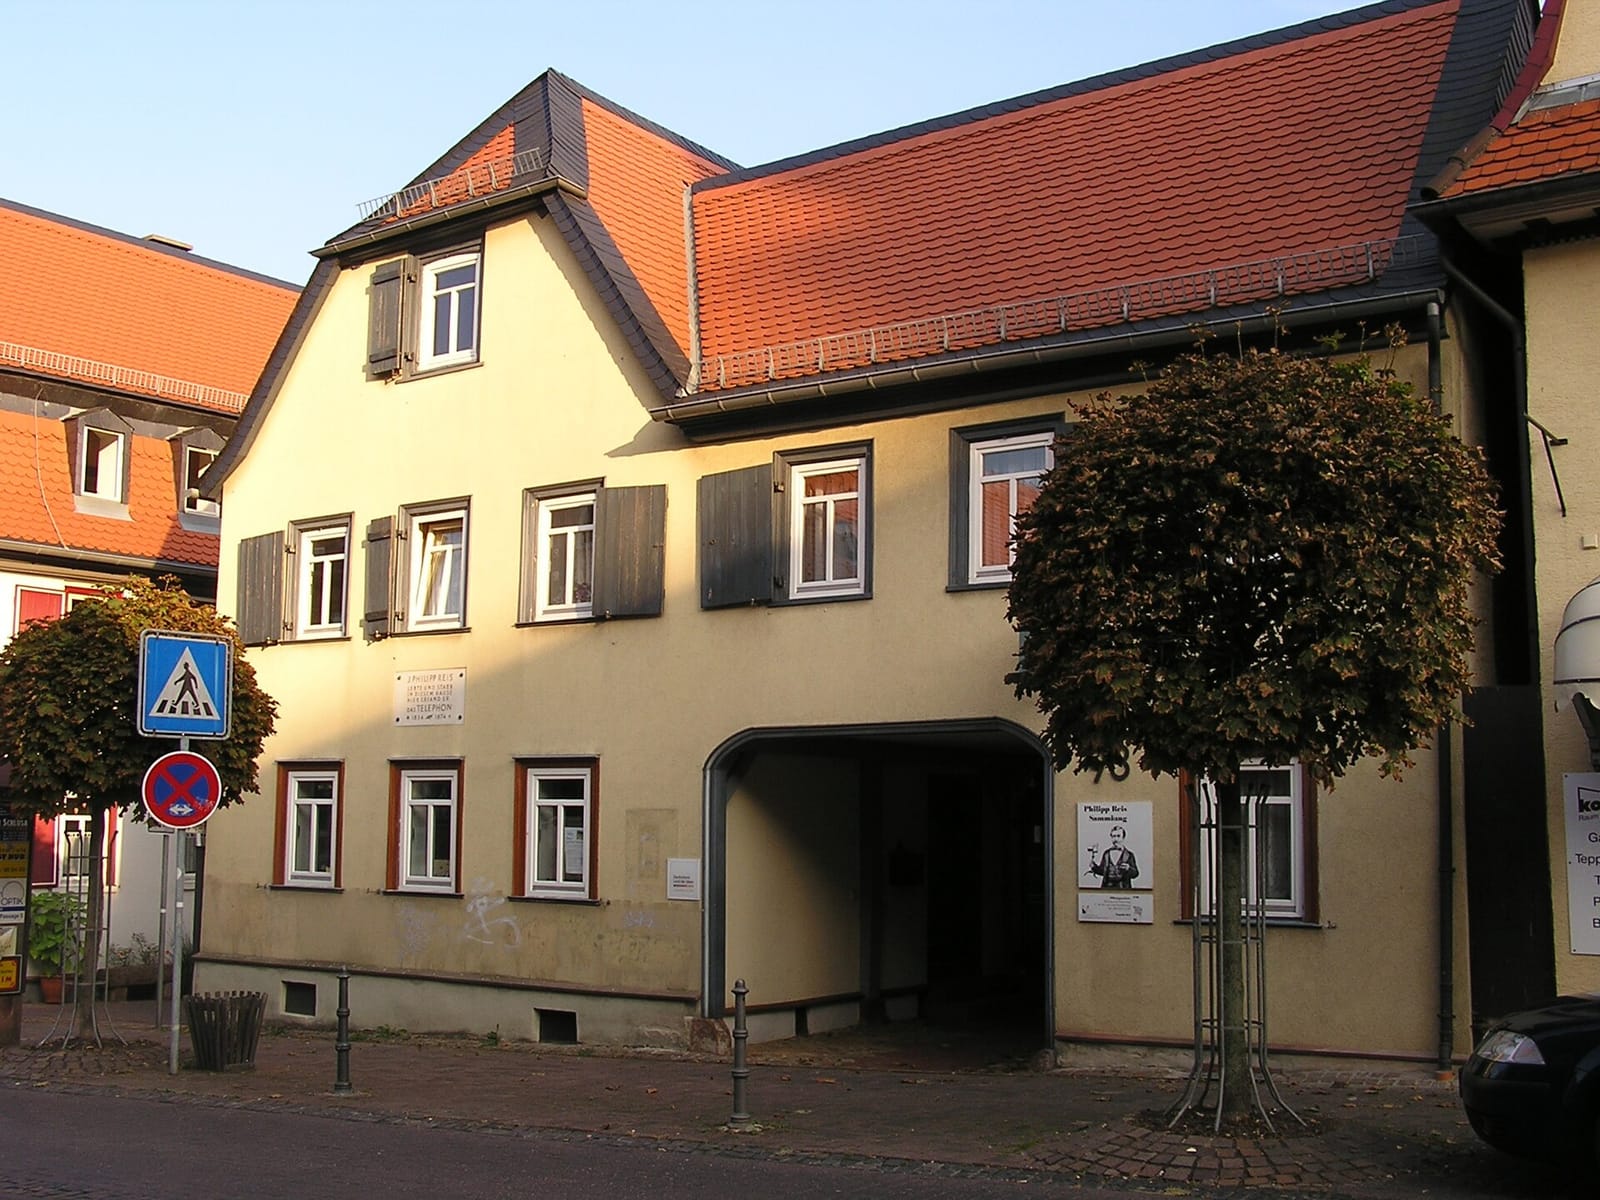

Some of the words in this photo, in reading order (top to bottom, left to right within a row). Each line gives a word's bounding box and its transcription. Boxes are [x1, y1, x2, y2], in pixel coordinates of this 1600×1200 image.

[412, 674, 437, 683] PHILIPP
[438, 673, 454, 682] REIS
[416, 704, 452, 712] TELEPHON
[1084, 805, 1110, 814] Philipp
[1112, 805, 1128, 813] Reis
[1089, 815, 1128, 823] Sammlung
[1, 897, 24, 906] OPTIK
